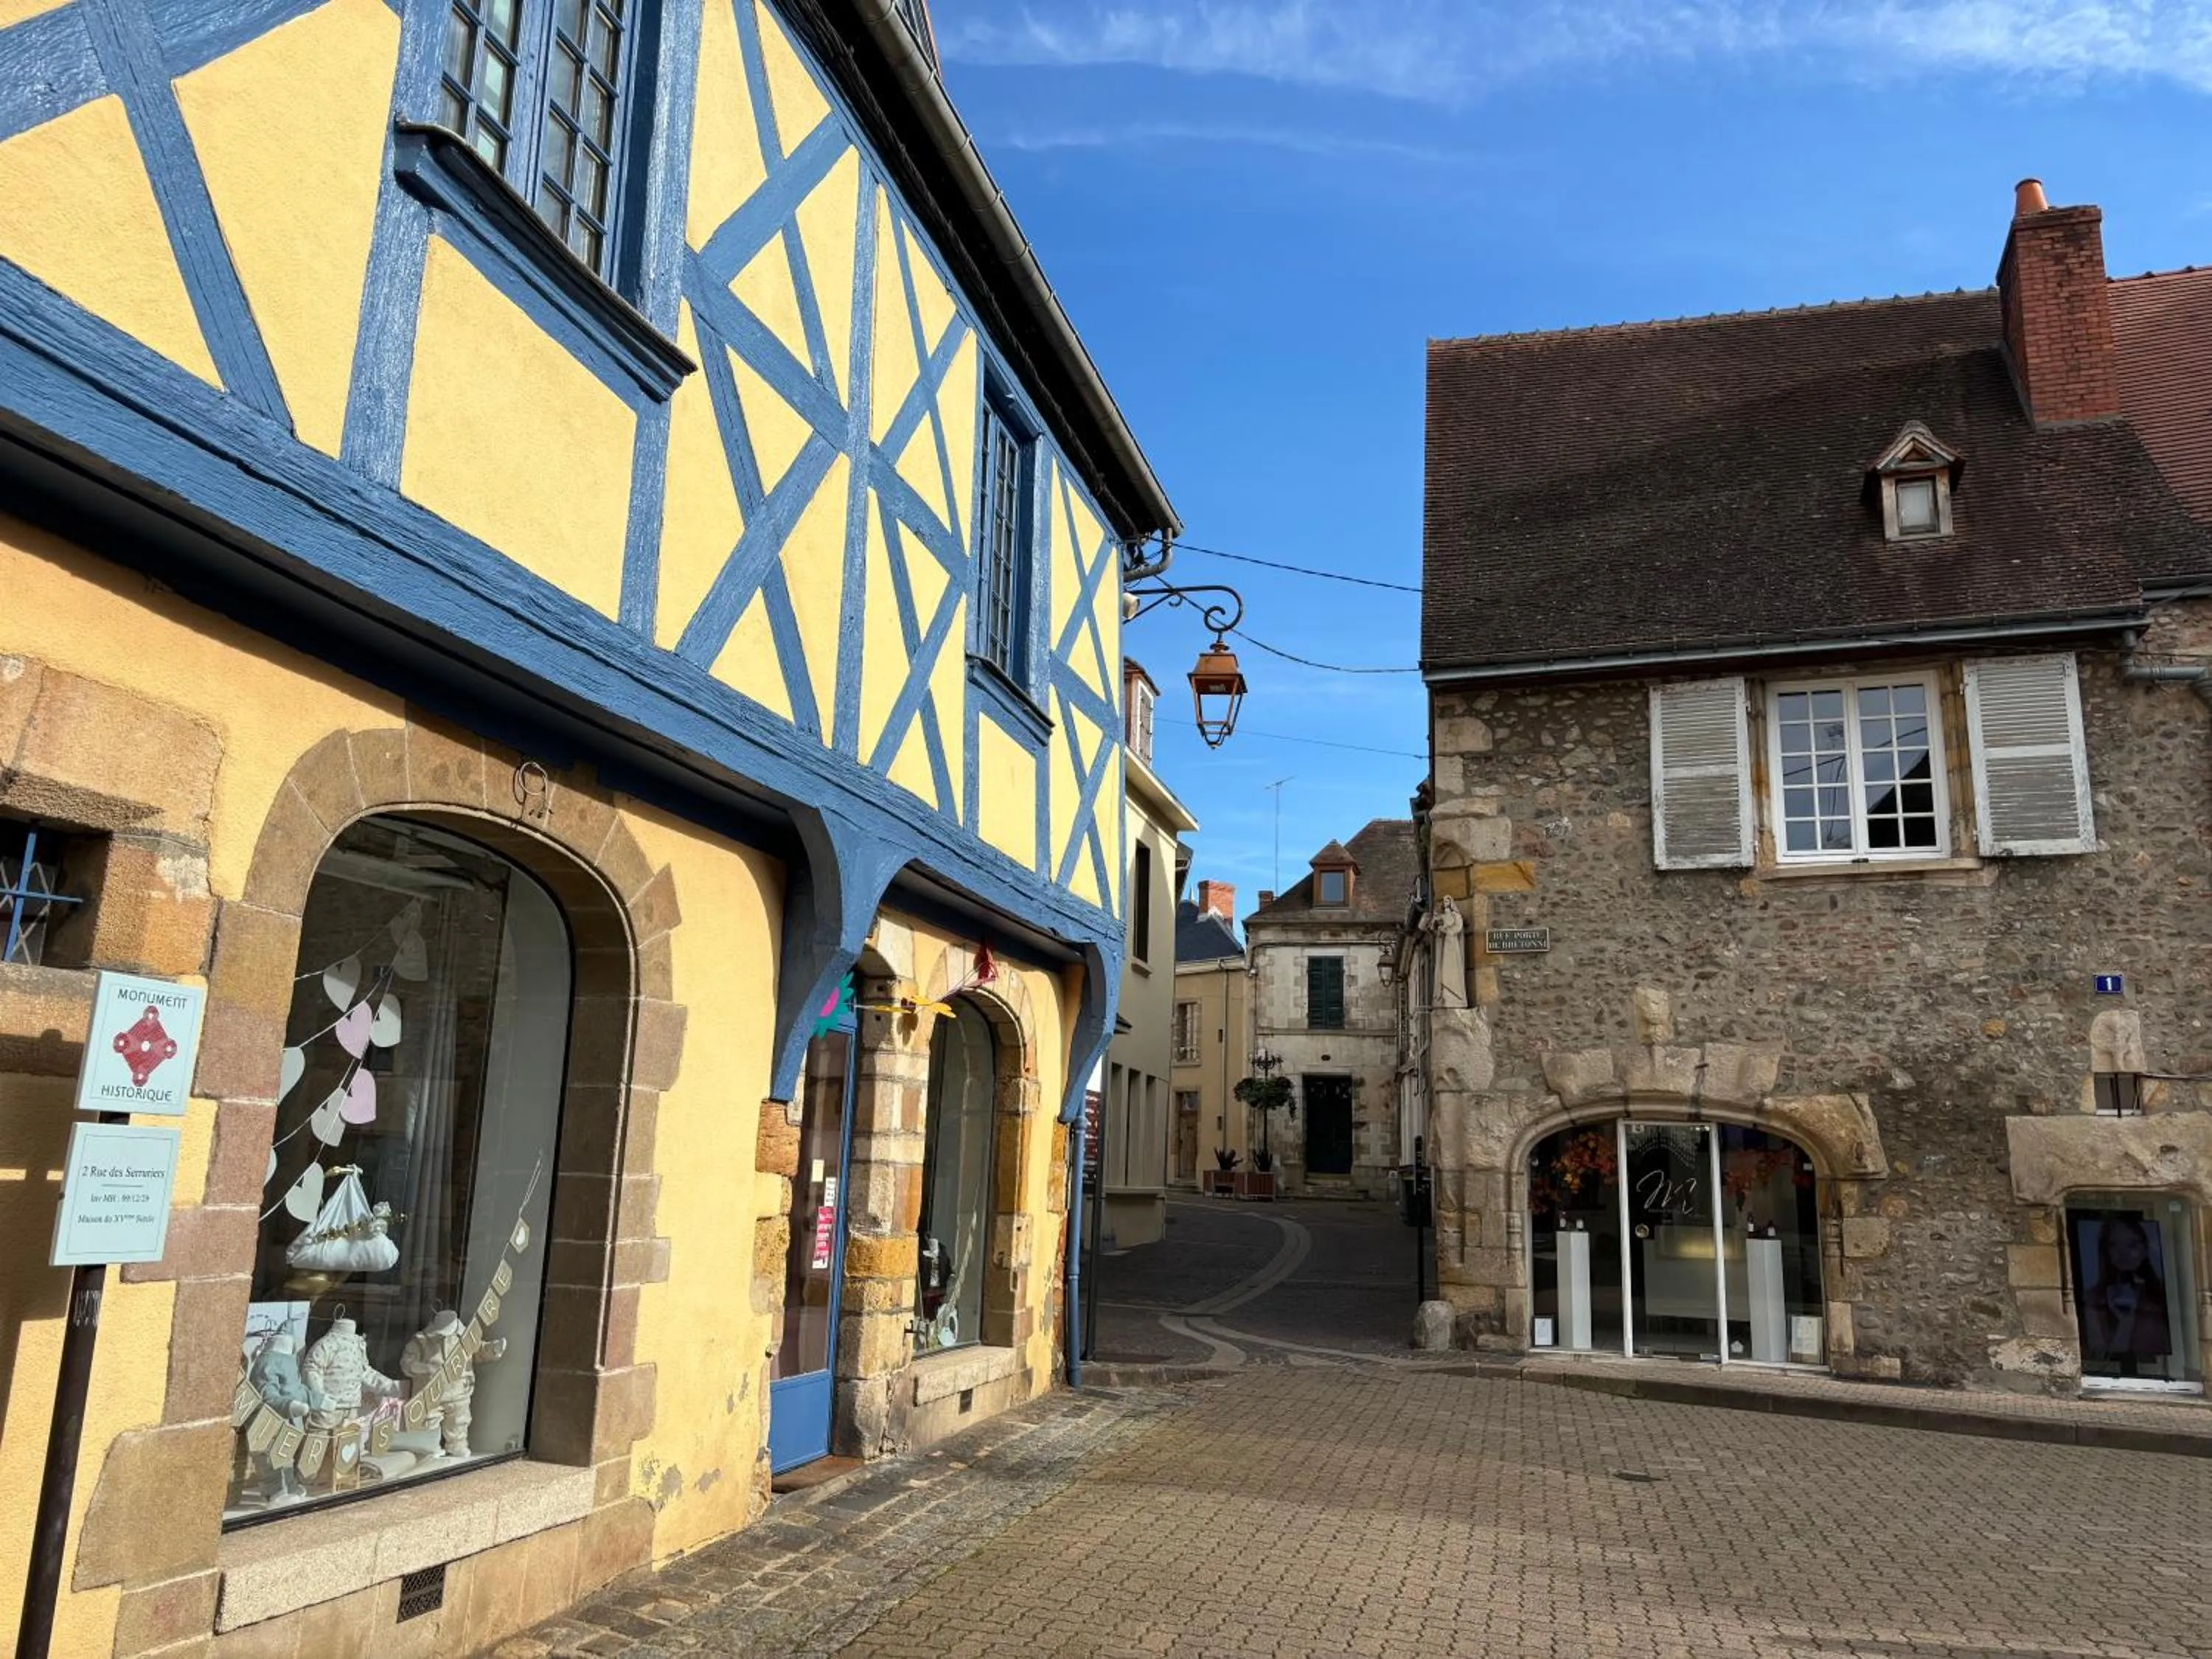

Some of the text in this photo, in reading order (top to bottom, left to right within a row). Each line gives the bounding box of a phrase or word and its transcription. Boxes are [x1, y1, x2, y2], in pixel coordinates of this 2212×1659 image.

[2105, 977, 2112, 990] 1
[118, 988, 188, 1009] MONUMENT
[101, 1085, 173, 1102] HISTORIQUE
[82, 1165, 165, 1178] 2 Rue des Serruriers
[77, 1214, 102, 1223] Maison
[378, 1269, 512, 1449] SOURIRE
